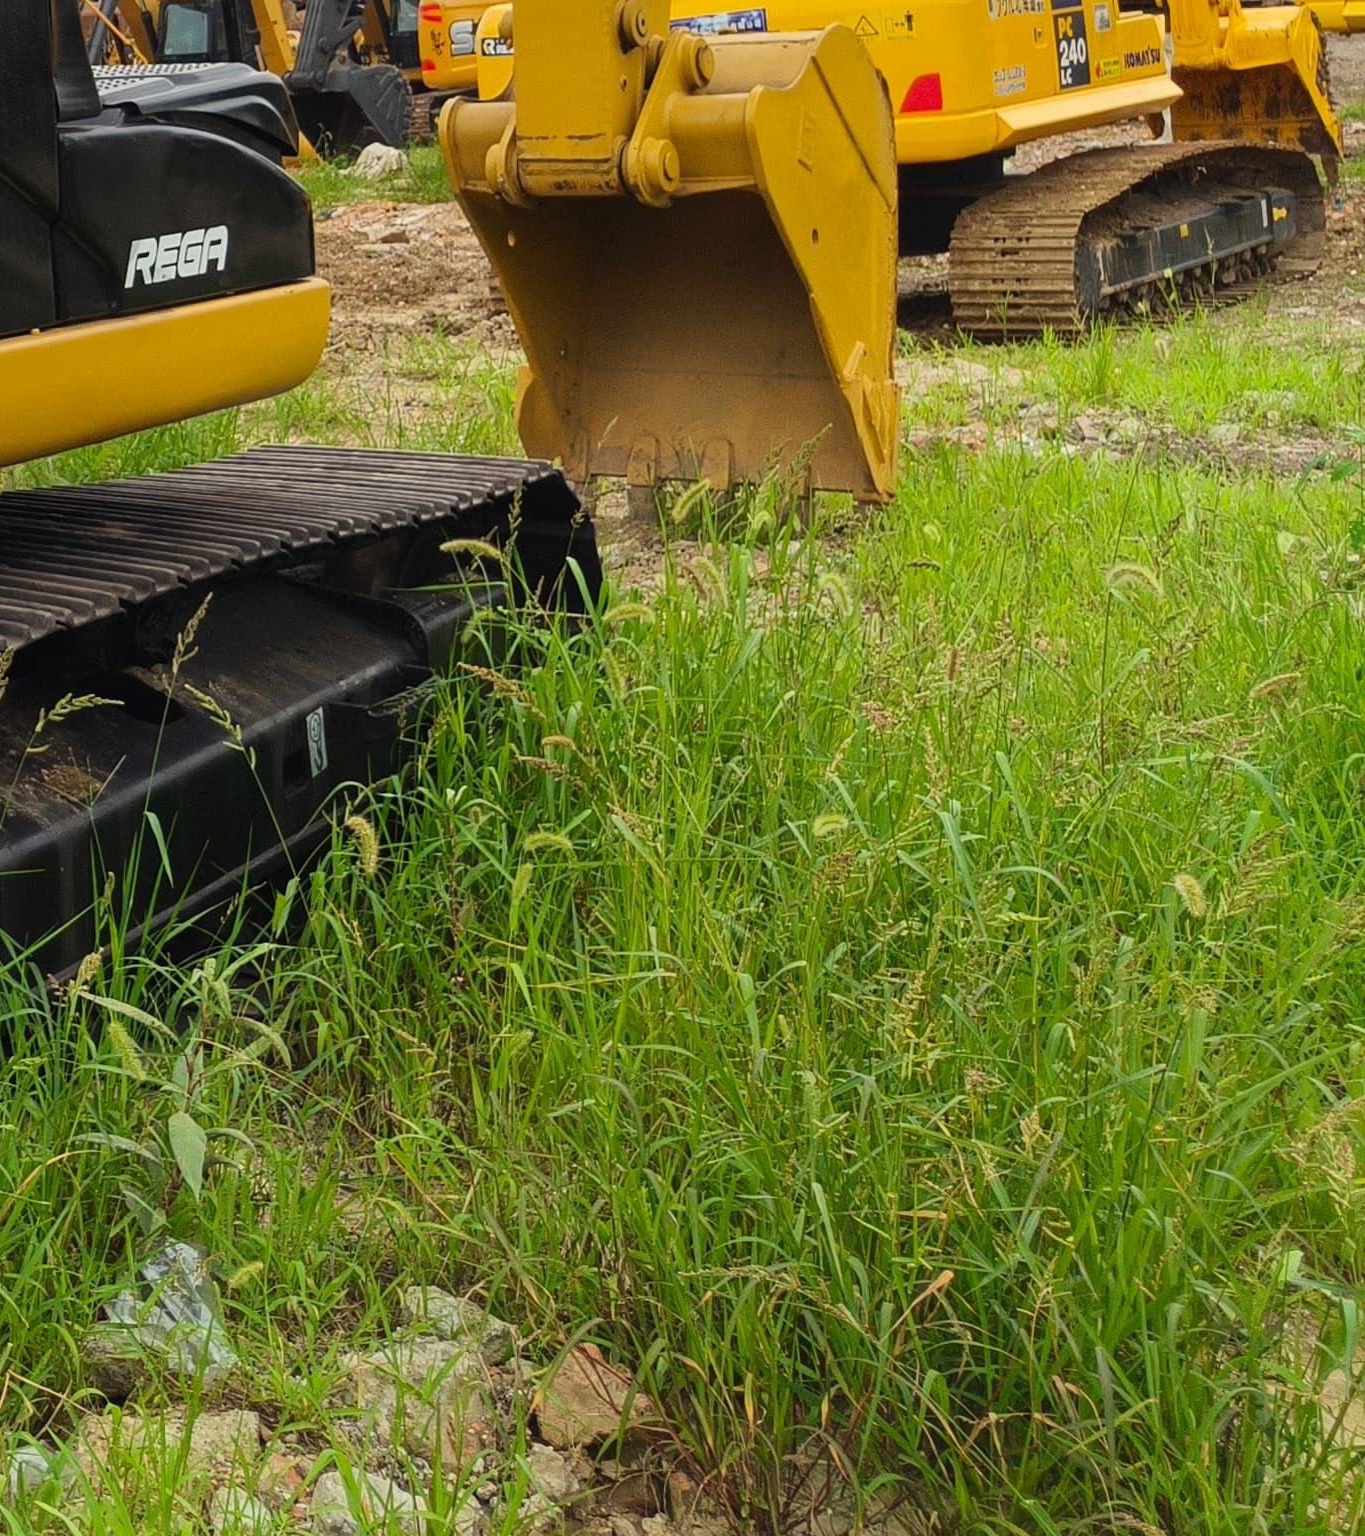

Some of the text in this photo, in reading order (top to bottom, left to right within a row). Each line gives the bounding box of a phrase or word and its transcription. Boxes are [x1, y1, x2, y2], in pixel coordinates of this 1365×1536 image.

[1058, 16, 1073, 38] PC
[1059, 37, 1087, 67] 240
[125, 225, 229, 288] REGA
